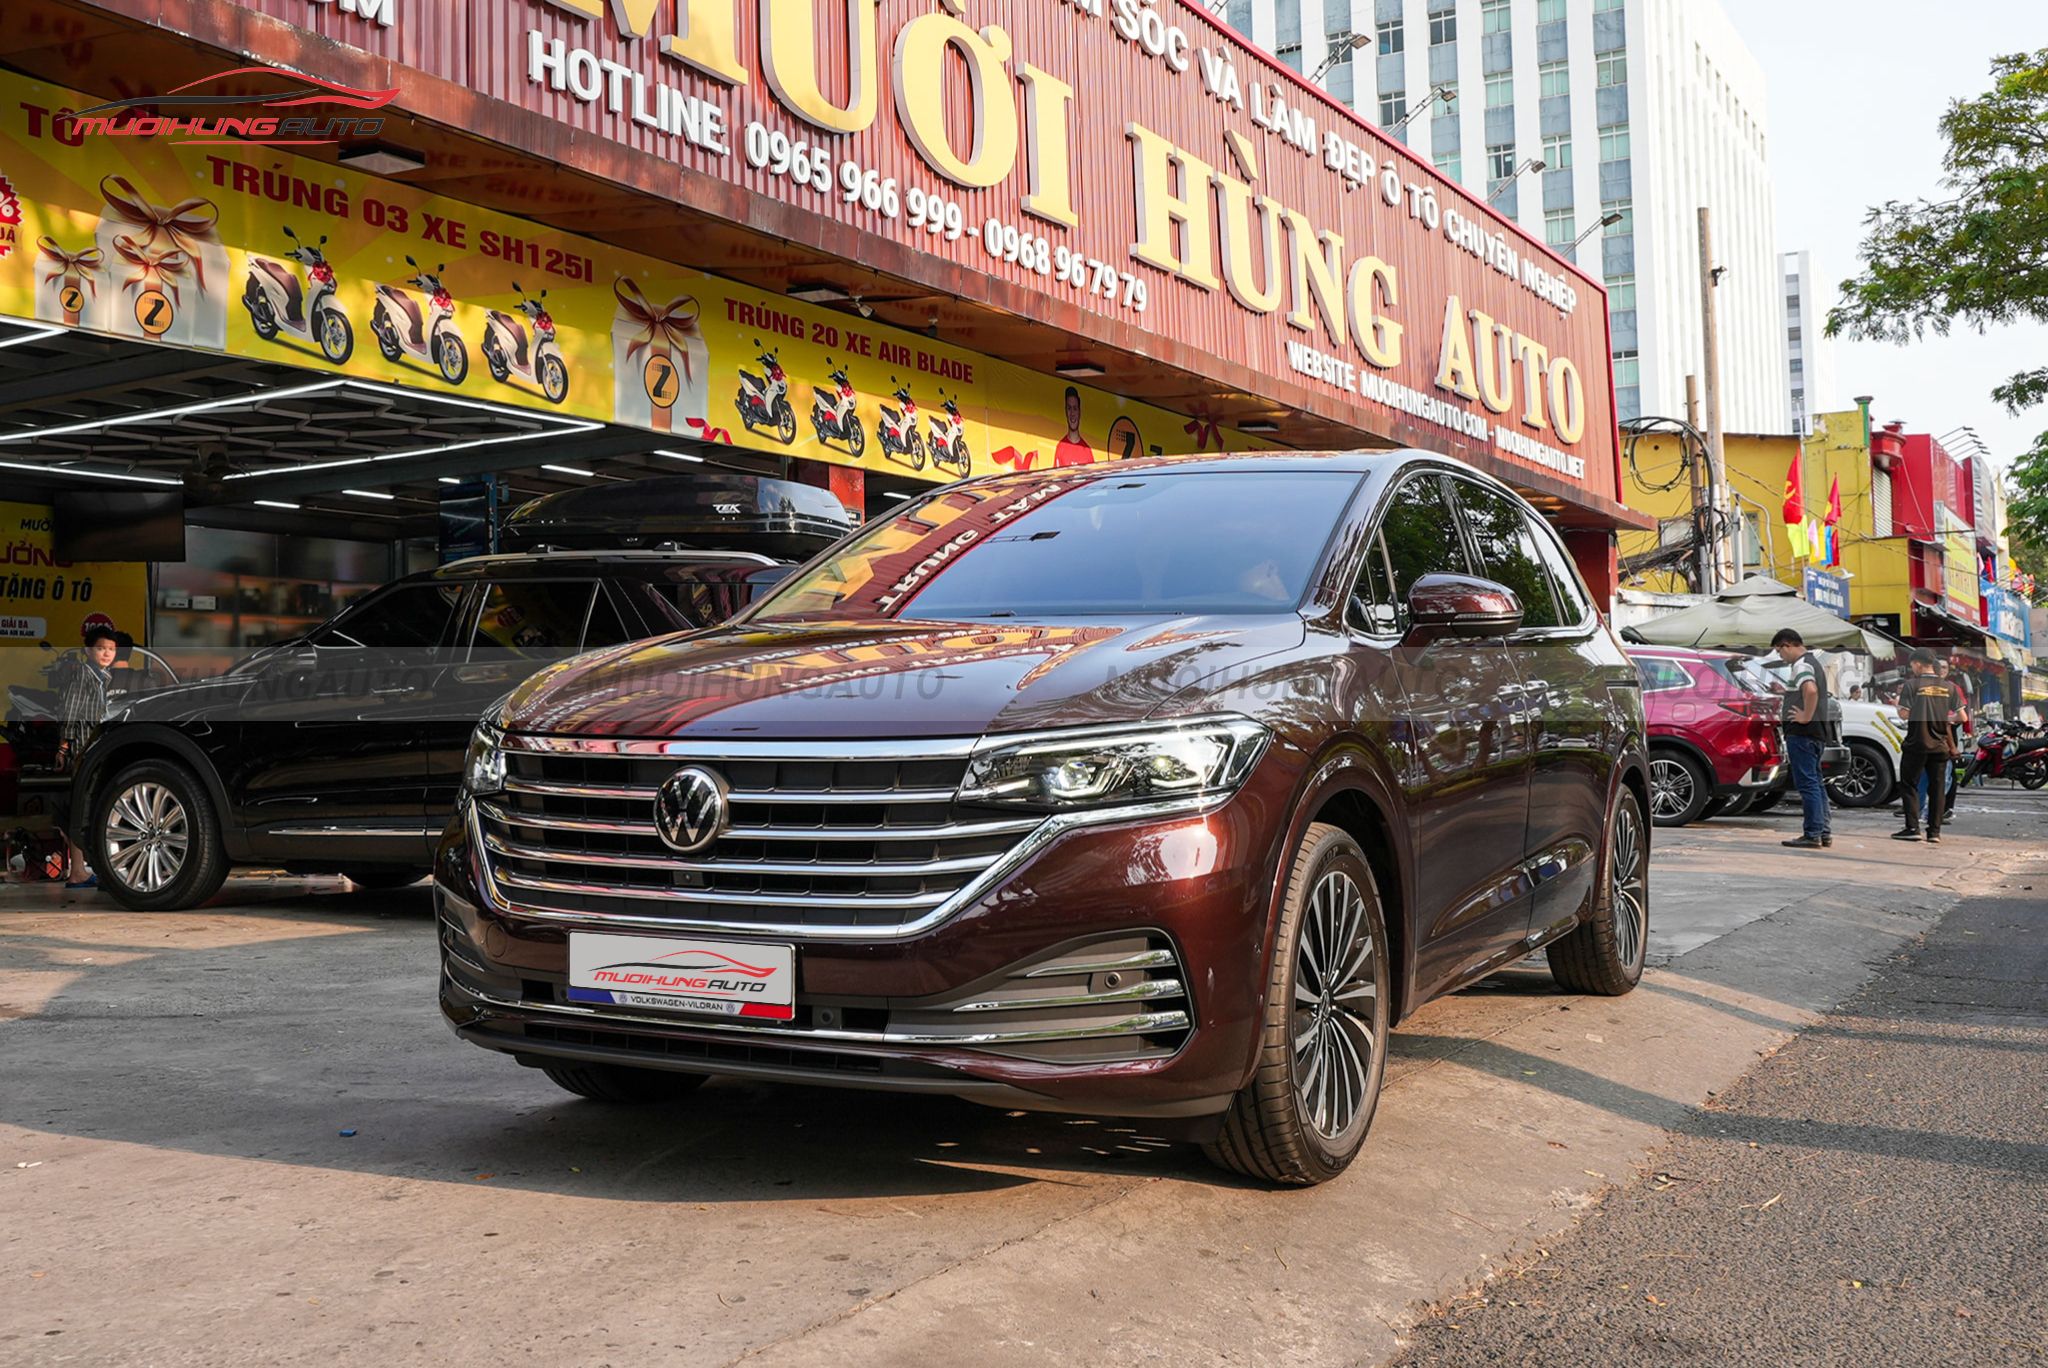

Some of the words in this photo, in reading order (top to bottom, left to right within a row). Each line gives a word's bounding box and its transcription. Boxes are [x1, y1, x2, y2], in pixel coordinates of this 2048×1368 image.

[206, 154, 349, 219] TRÚNG
[363, 198, 409, 233] 03
[422, 214, 466, 249] XE
[480, 229, 593, 283] SH125I
[745, 121, 833, 194] 0965
[839, 160, 899, 219] 966
[907, 187, 963, 241] 999
[984, 217, 1051, 276] 0968
[1197, 46, 1243, 112] VÀ
[1249, 82, 1317, 157] LÀM
[1324, 130, 1377, 193] ĐẸP
[1381, 160, 1401, 207] Ô
[1405, 182, 1440, 231] TÔ
[1443, 208, 1519, 282] CHUYÊN
[1520, 257, 1577, 320] NGHIỆP
[724, 297, 805, 340] TRÚNG
[810, 323, 839, 348] 20
[845, 332, 873, 356] XE
[877, 339, 912, 367] AIR
[916, 350, 974, 384] BLADE
[1124, 121, 1403, 368] HÙNG
[1434, 295, 1585, 445] AUTO
[1288, 339, 1356, 394] WEBSITE
[71, 577, 93, 601] TÔ
